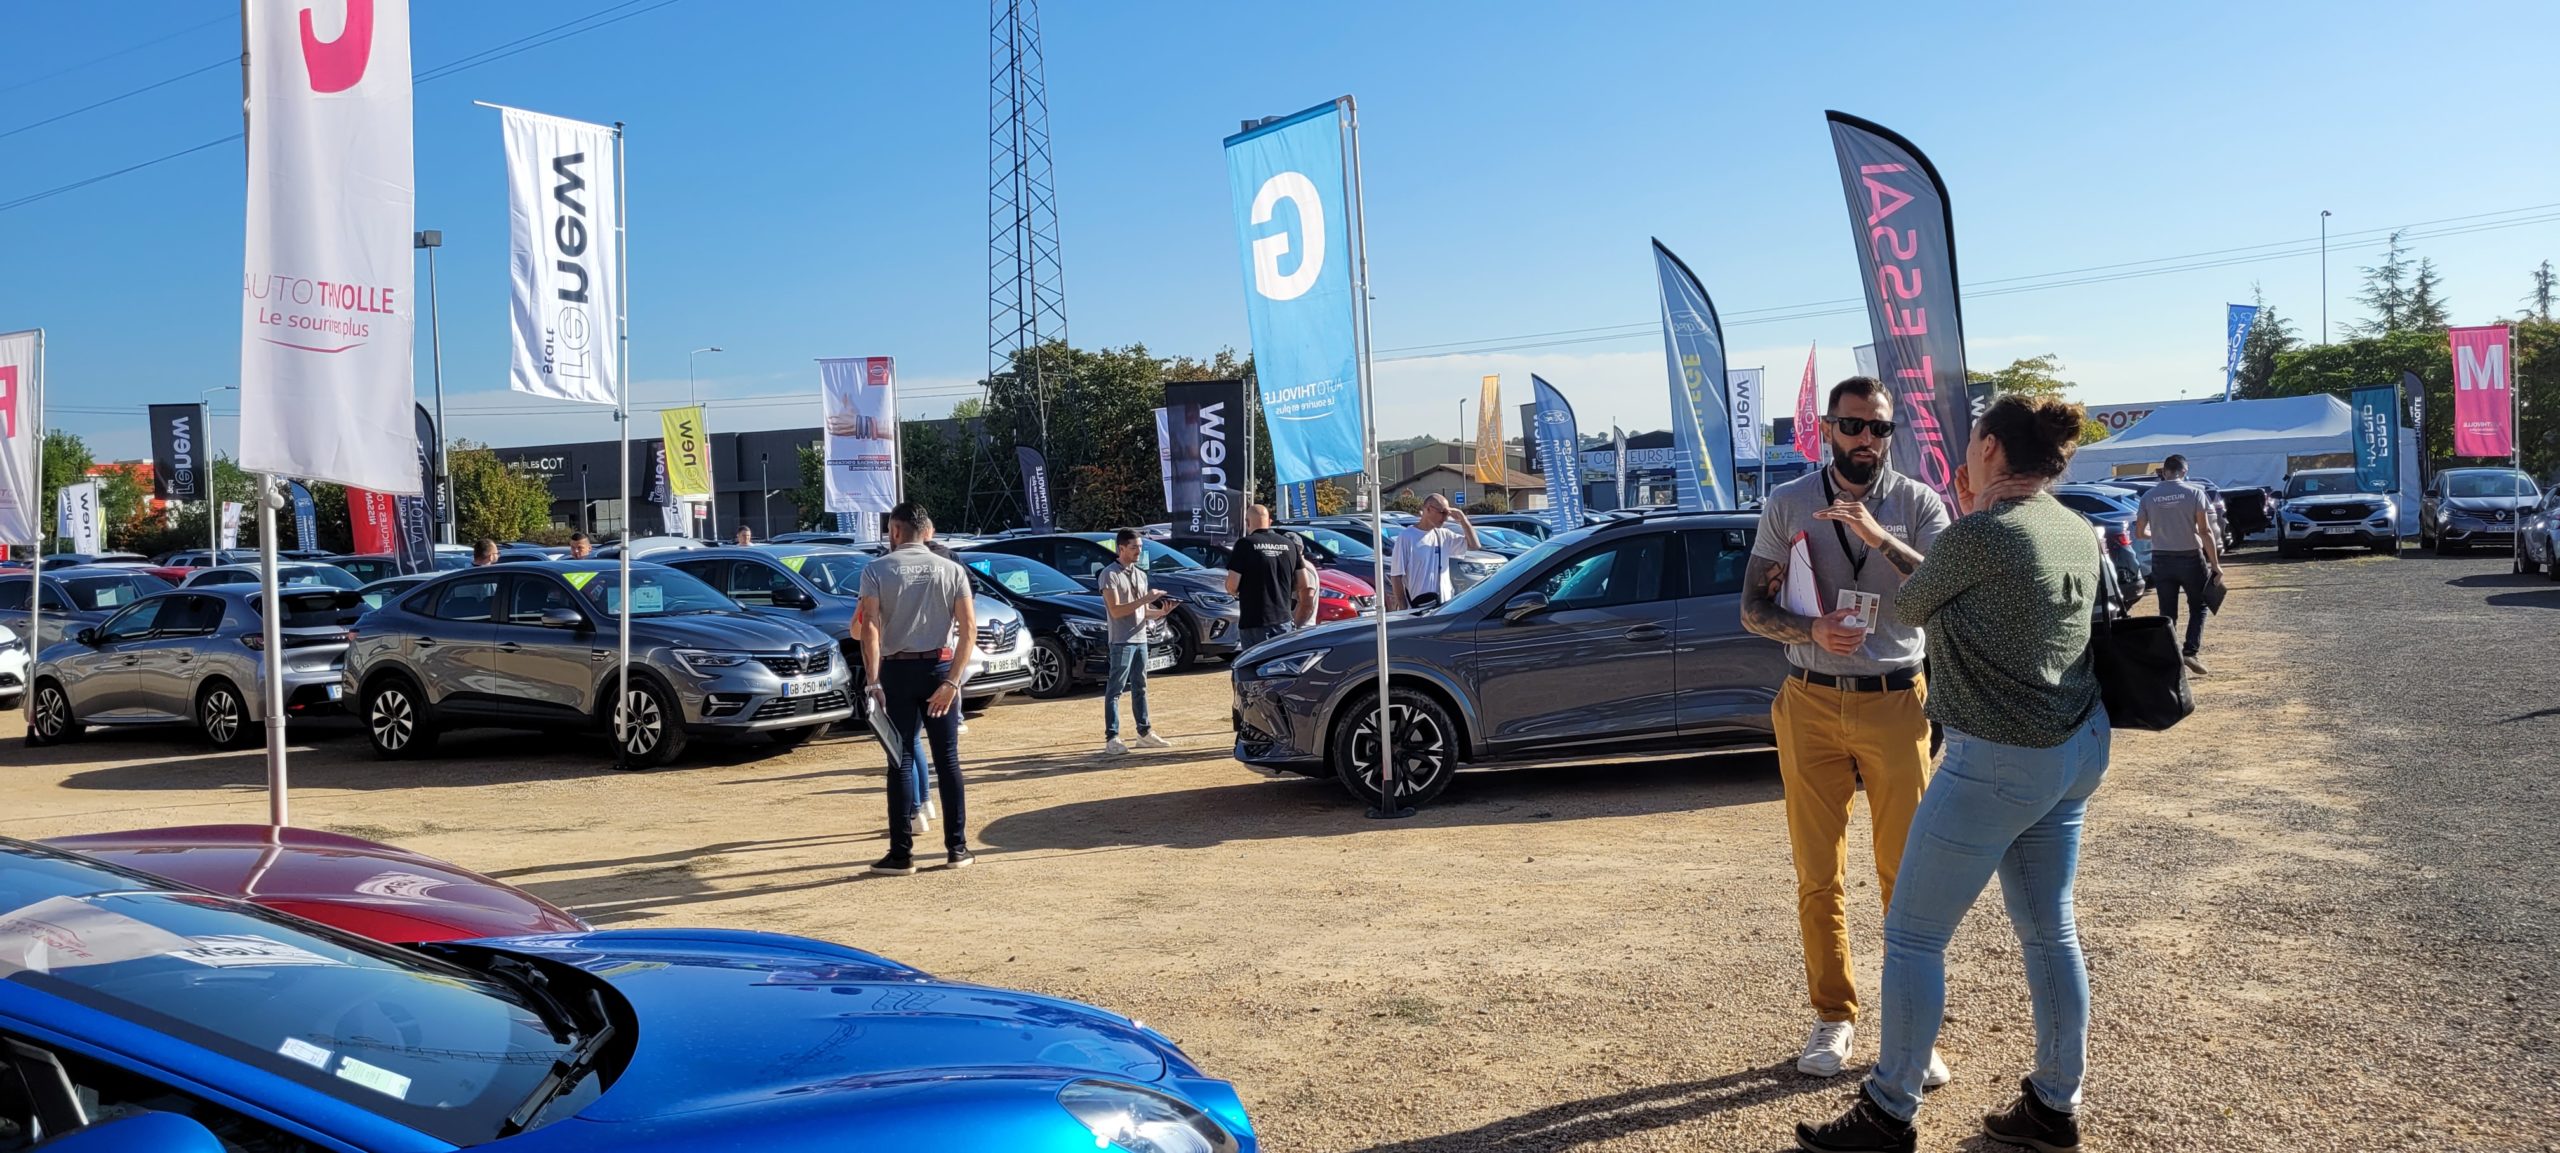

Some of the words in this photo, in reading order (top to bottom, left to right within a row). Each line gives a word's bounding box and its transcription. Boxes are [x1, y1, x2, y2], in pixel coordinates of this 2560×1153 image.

[259, 307, 282, 326] Le
[343, 317, 369, 339] plus
[1594, 449, 1663, 464] COEURS
[540, 457, 564, 470] COT
[1253, 543, 1289, 551] MANAGER
[891, 564, 945, 576] VENDEUR
